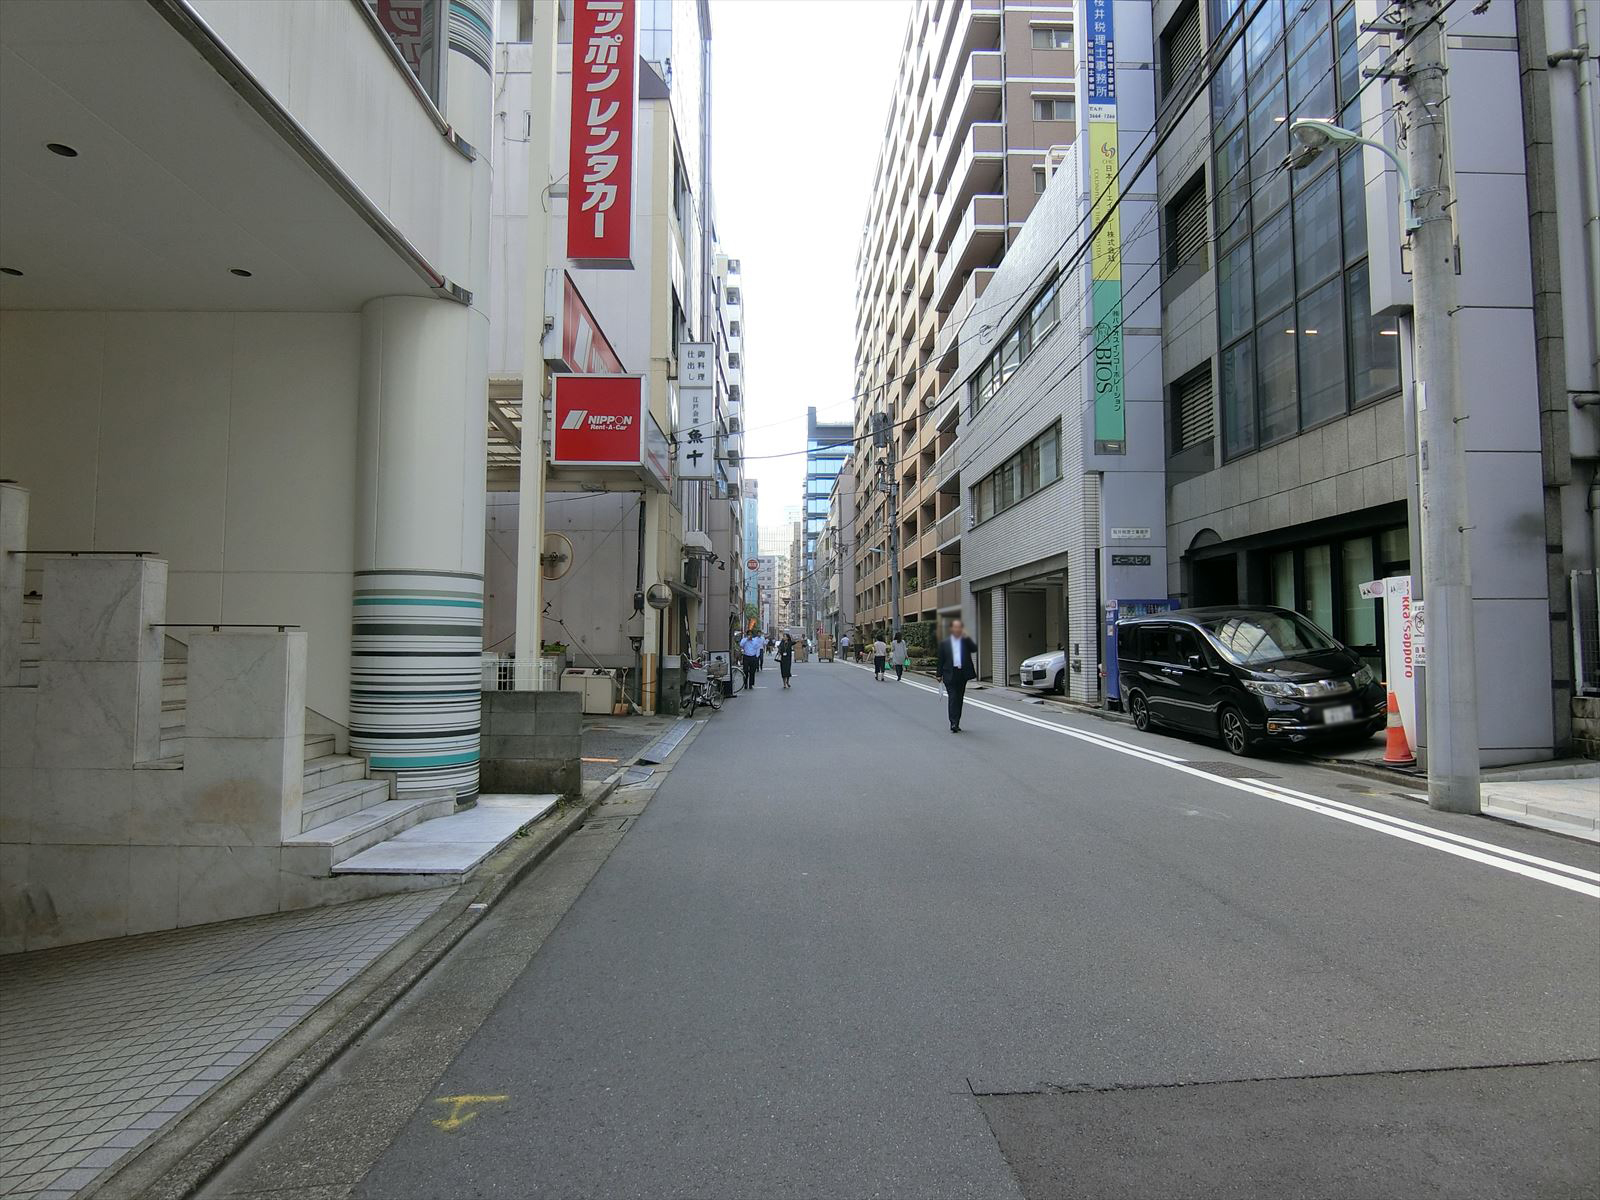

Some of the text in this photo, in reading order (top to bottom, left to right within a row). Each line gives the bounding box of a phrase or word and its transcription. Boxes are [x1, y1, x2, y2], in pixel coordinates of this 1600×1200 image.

[687, 350, 695, 381] 仕出し
[697, 350, 705, 381] 御料理
[1096, 348, 1112, 394] BIOS
[588, 415, 632, 425] NIPPON
[686, 429, 704, 469] 魚十
